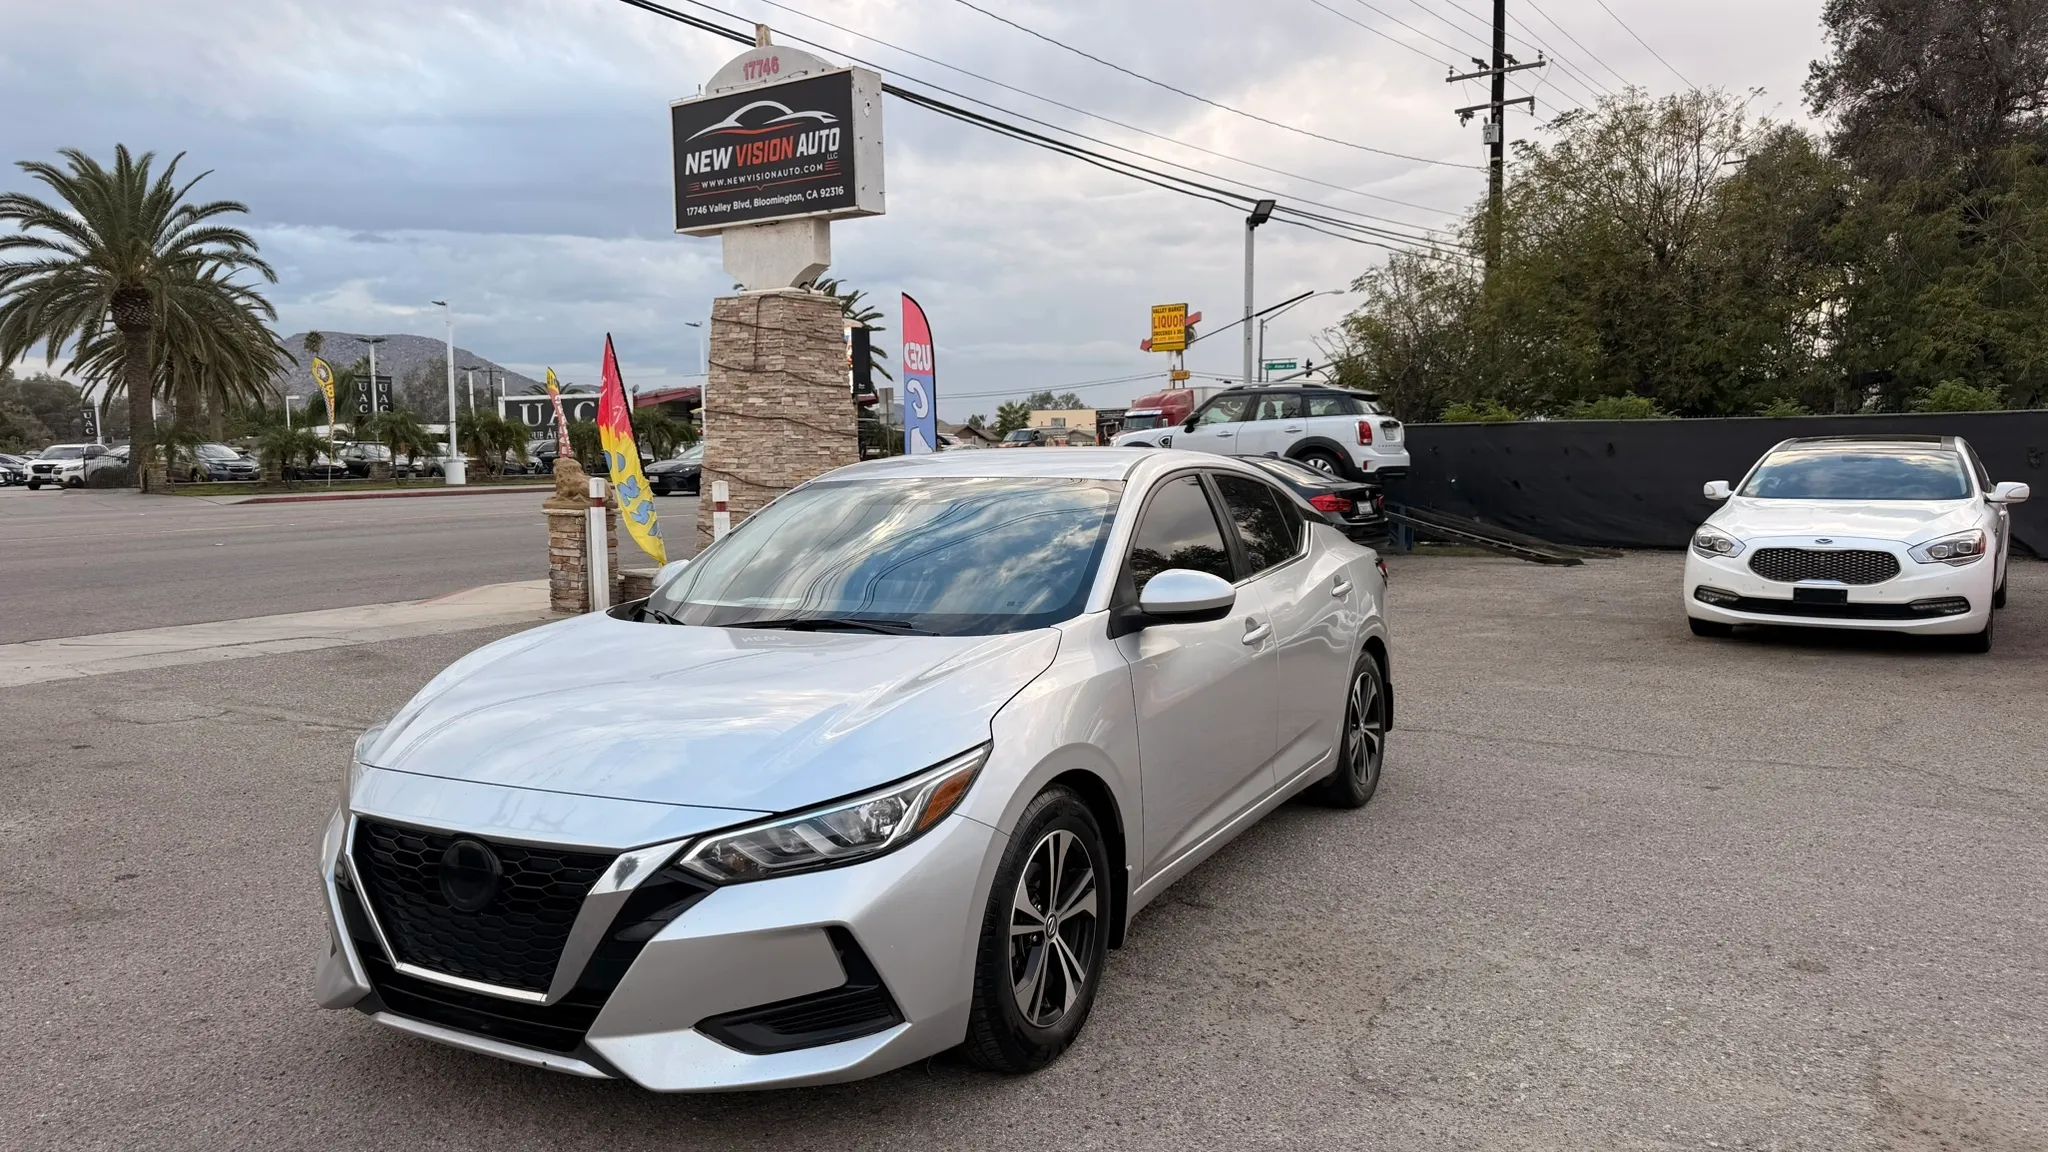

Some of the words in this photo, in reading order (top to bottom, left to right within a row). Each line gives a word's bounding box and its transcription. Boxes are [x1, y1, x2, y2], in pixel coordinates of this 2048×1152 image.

[743, 56, 780, 80] 17746
[685, 146, 733, 176] NEW
[735, 136, 795, 167] VISION
[796, 126, 840, 157] AUTO
[827, 152, 839, 160] LLC
[701, 164, 823, 188] WWW.NEWVISIONAUTO.COM
[686, 205, 708, 217] 17746
[709, 201, 731, 216] Valley
[733, 198, 752, 211] Blvd,
[753, 190, 805, 208] Bloomington,
[806, 189, 819, 200] CA
[820, 186, 844, 198] 92316
[1153, 314, 1185, 329] LIQUOR
[358, 382, 368, 414] UAC
[378, 383, 389, 413] UAC
[83, 412, 94, 434] UAC
